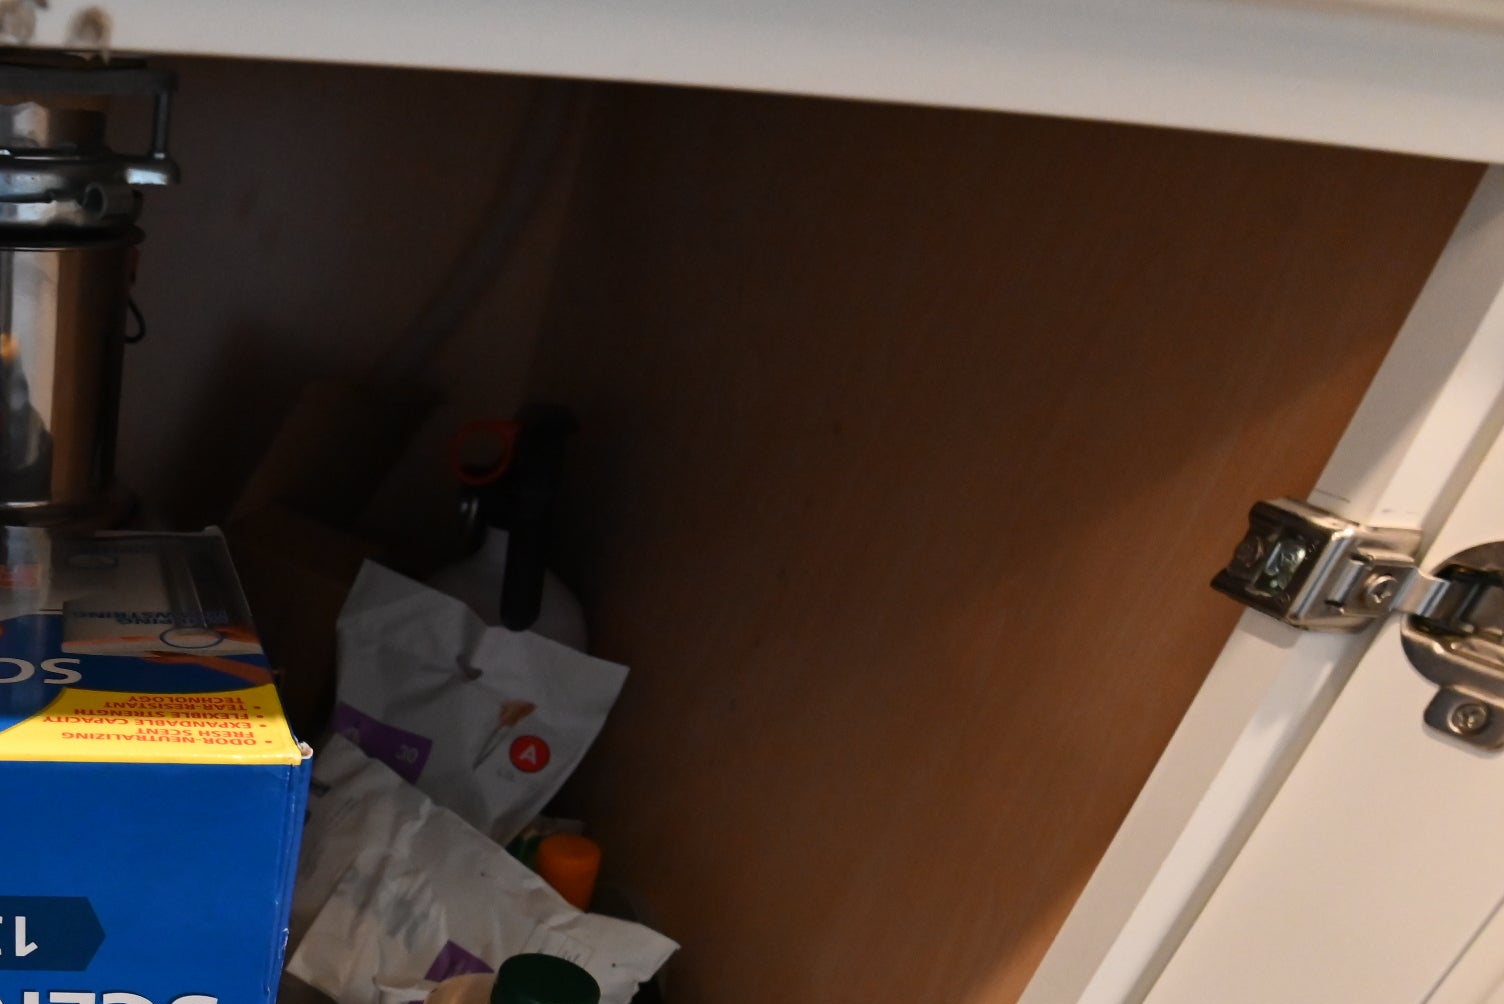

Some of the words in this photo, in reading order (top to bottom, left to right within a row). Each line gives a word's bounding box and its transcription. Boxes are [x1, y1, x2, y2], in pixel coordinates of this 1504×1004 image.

[127, 695, 244, 703] TECHNOLOGY
[103, 701, 247, 711] TEAR-RESISTANT
[74, 709, 166, 719] STRENGTH
[170, 711, 250, 720] FLEXIBLE
[42, 716, 129, 726] CAPACITY
[135, 718, 252, 729] EXPANDABLE
[135, 728, 193, 737] SCENT
[198, 729, 255, 739] FRESH
[61, 732, 257, 746] ODOR-NEUTRALIZING
